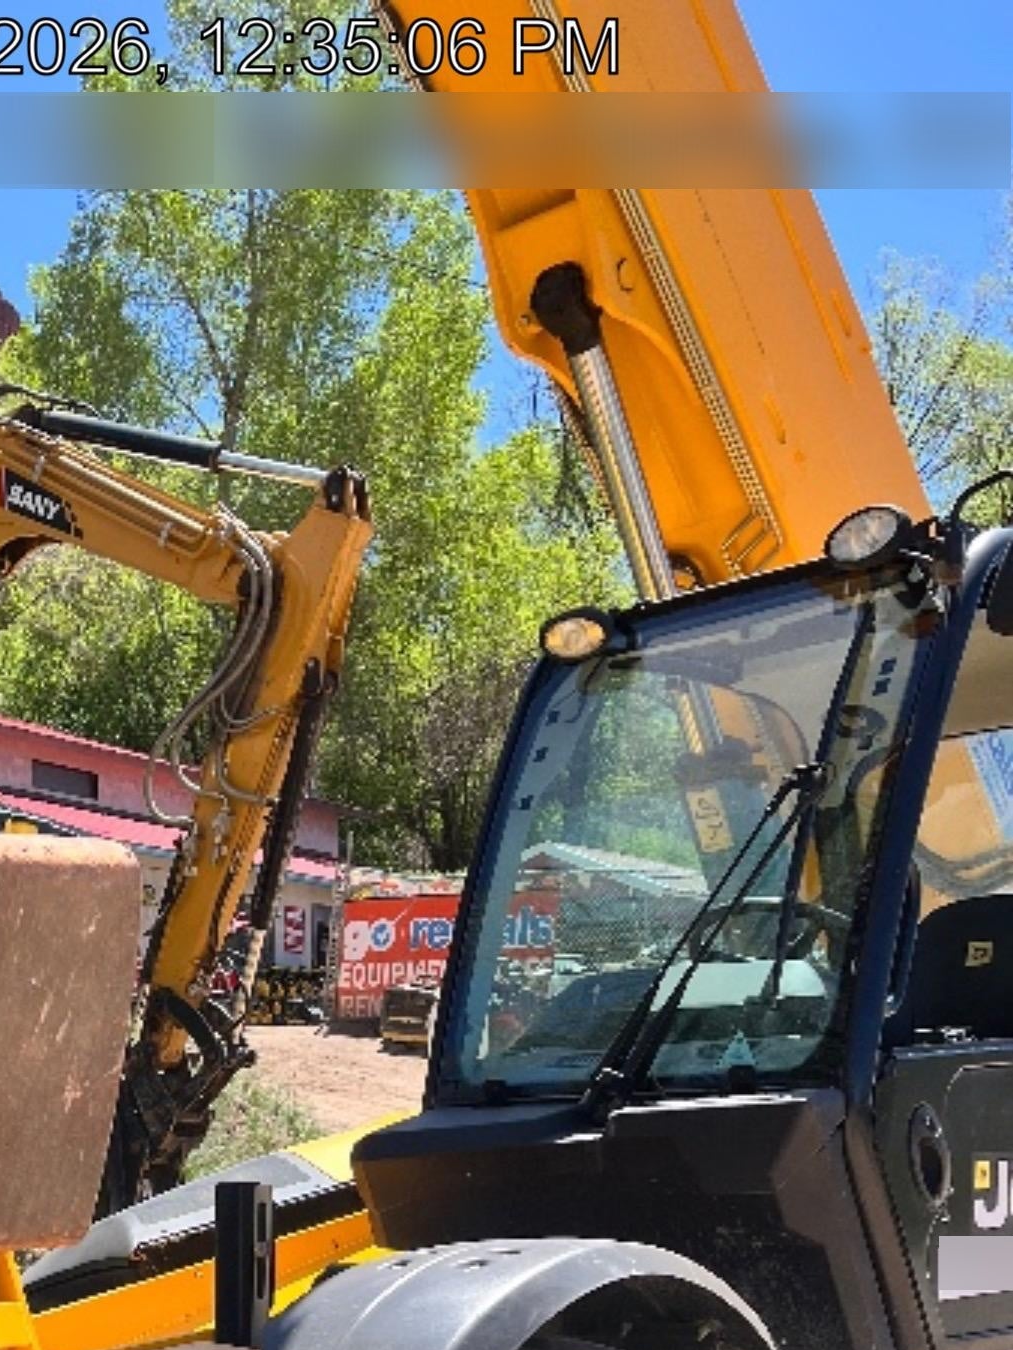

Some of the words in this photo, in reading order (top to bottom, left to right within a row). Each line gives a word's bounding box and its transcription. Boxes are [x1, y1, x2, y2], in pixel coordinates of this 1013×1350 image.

[8, 484, 61, 520] SANY
[344, 918, 395, 961] go
[410, 905, 555, 950] reals
[338, 960, 447, 990] EQUIPME
